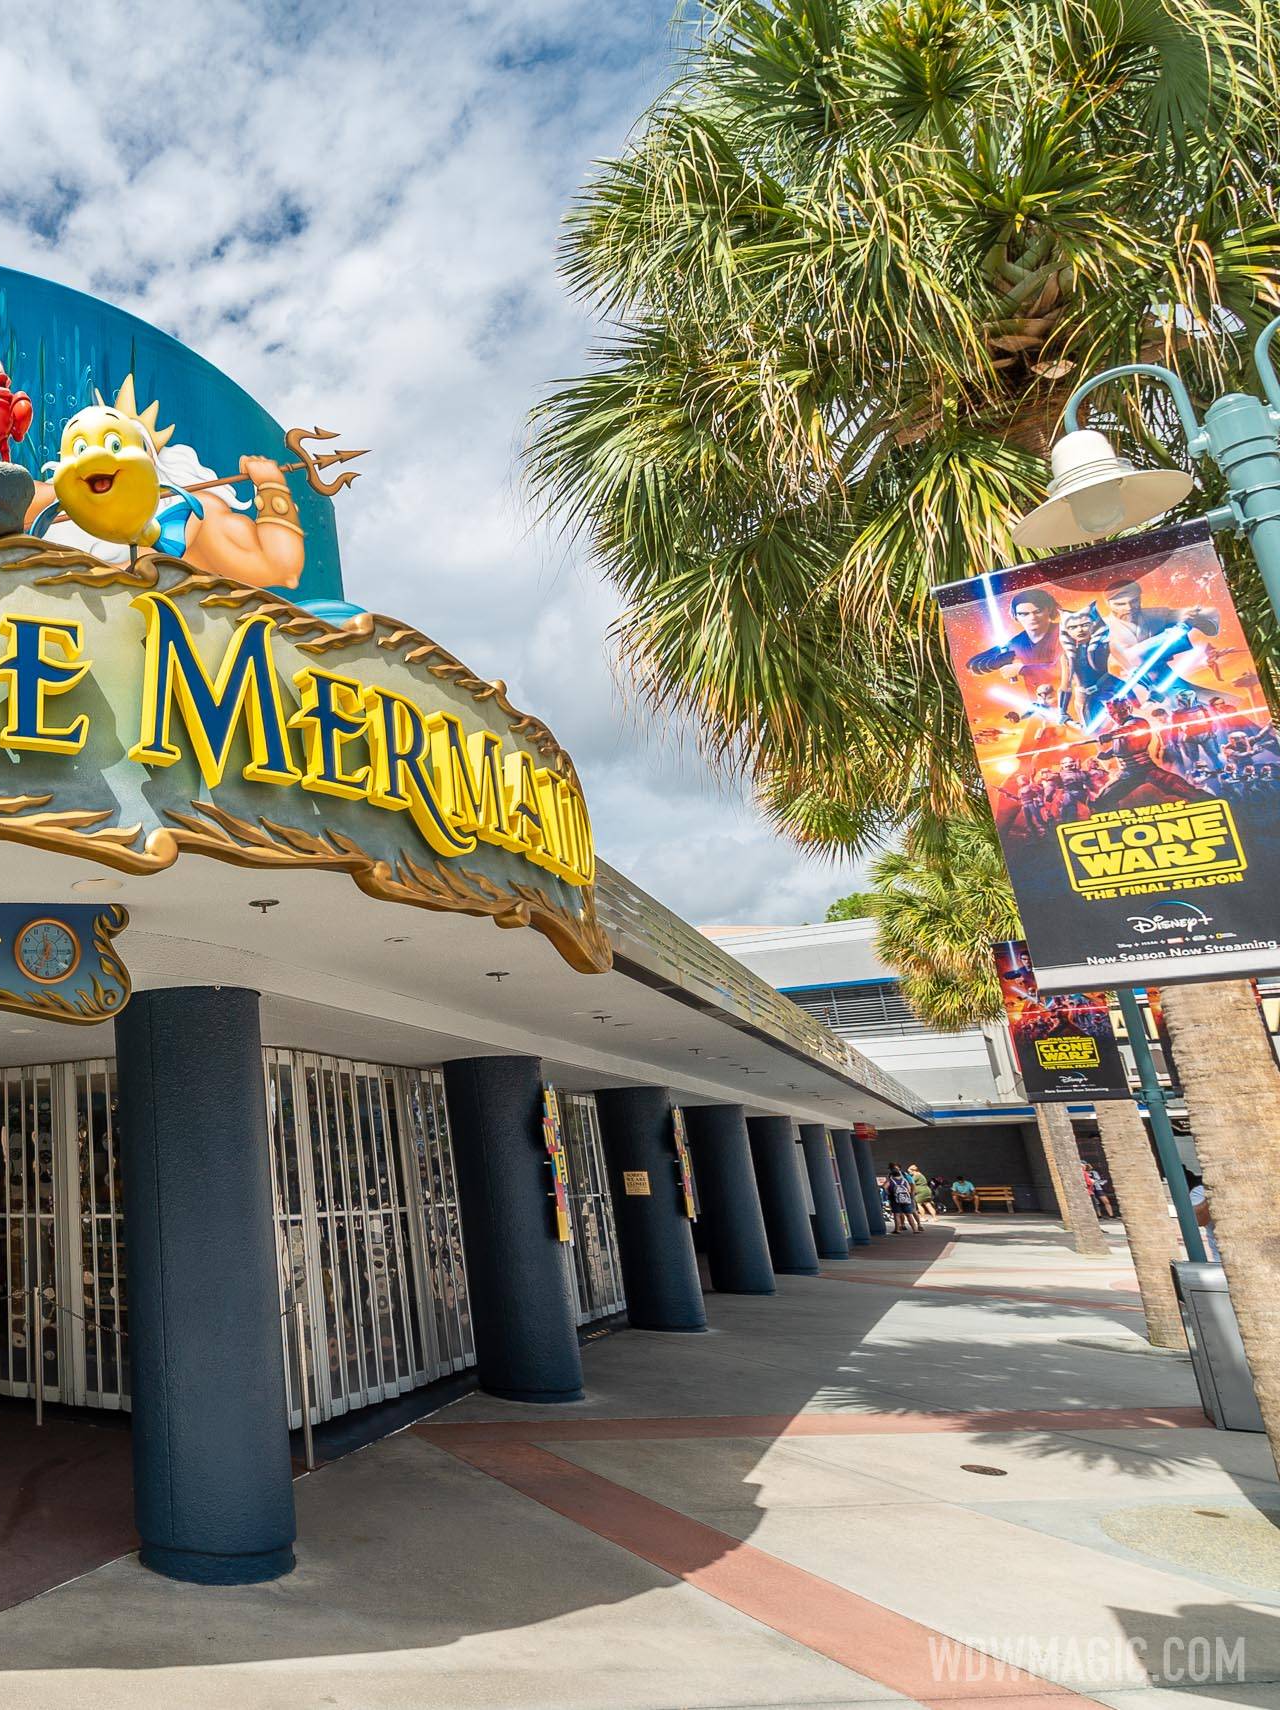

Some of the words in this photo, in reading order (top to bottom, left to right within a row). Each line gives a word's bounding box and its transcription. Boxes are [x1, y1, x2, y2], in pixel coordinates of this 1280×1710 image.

[128, 591, 595, 887] MERMAID
[1090, 809, 1135, 823] STAR
[1134, 800, 1187, 816] WARS
[1122, 815, 1154, 825] THE
[1069, 812, 1228, 855] CLONE
[1077, 836, 1226, 878] WARS
[1081, 888, 1118, 901] THE
[1120, 882, 1171, 897] FINAL
[1172, 872, 1245, 891] SEASON
[1086, 955, 1117, 967] New
[1119, 949, 1167, 963] Season
[1170, 946, 1202, 957] Now
[1205, 939, 1278, 955] Streaming
[1039, 1042, 1094, 1053] CLONE
[1042, 1050, 1093, 1061] WARS
